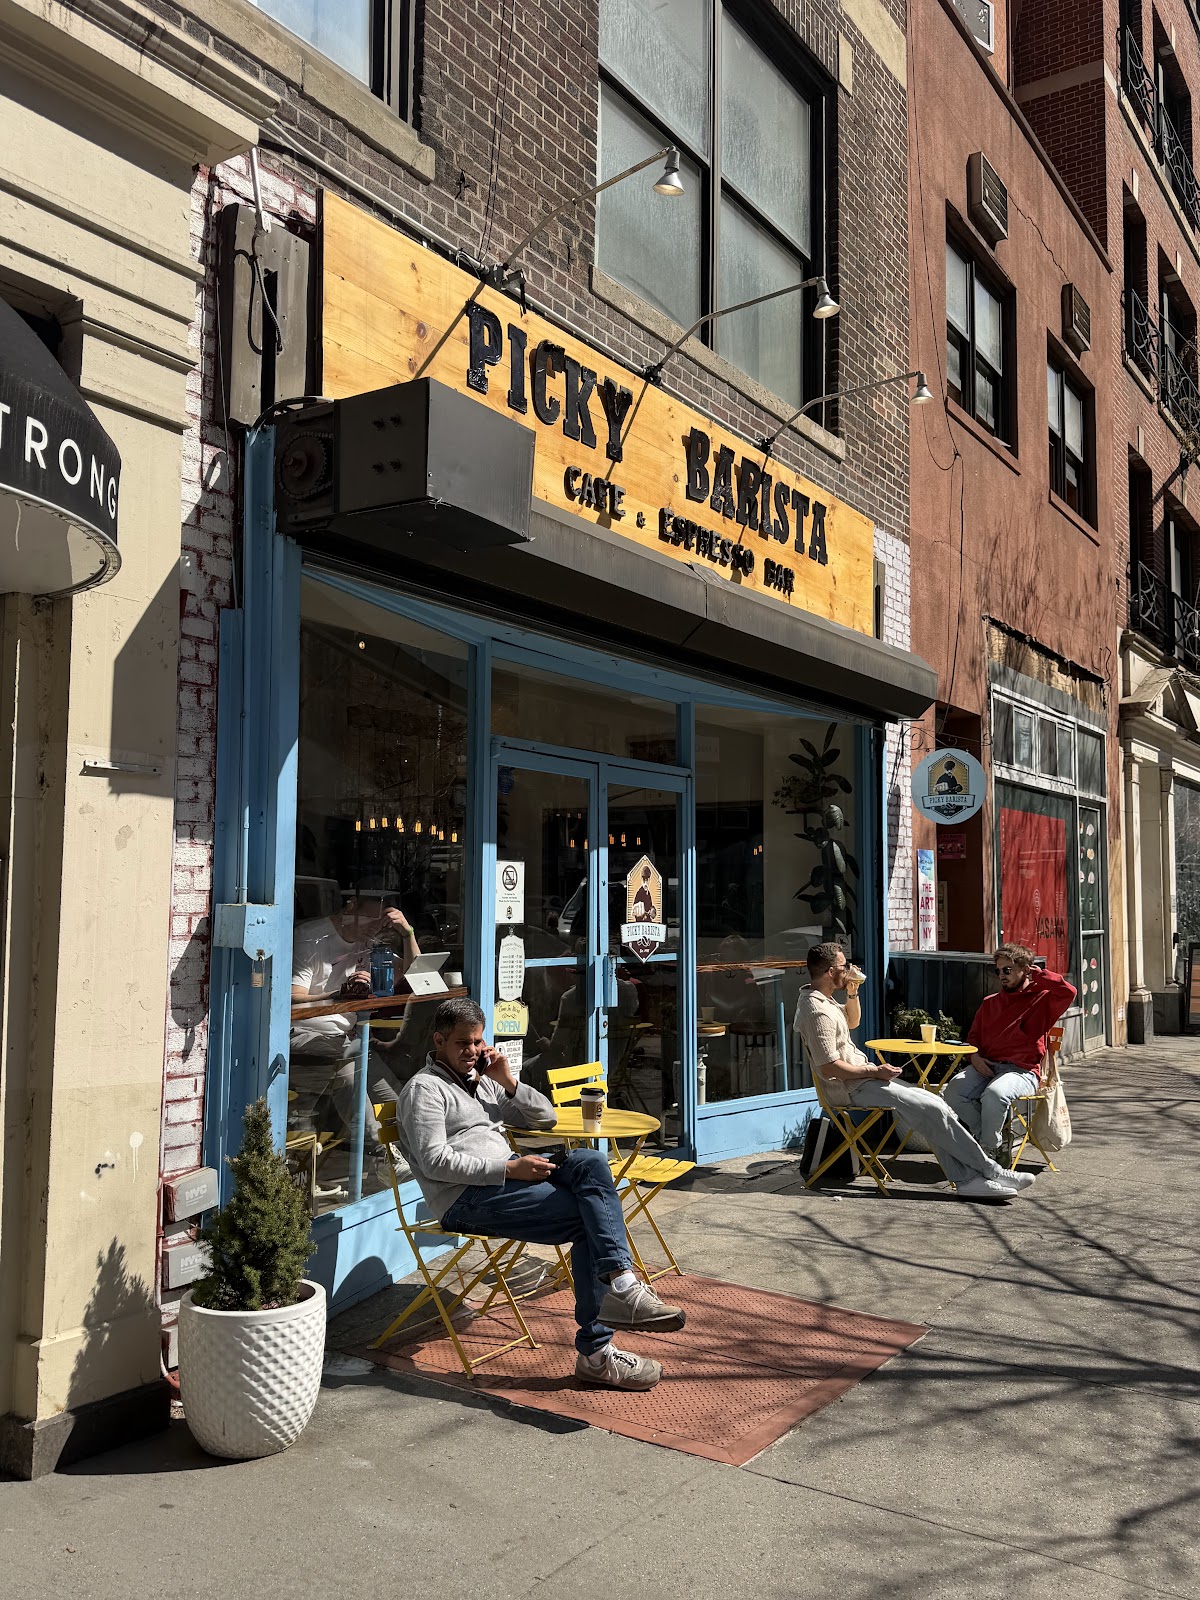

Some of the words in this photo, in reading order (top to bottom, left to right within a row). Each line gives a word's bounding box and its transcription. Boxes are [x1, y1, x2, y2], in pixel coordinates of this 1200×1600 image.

[465, 298, 633, 462] PICKY
[684, 426, 829, 566] BARISTA
[564, 466, 626, 519] CAFE
[636, 511, 646, 528] &
[659, 508, 755, 576] ESPRESSO
[764, 558, 795, 592] BAR
[922, 883, 932, 893] THE
[919, 896, 935, 910] ART
[922, 927, 932, 939] NY
[496, 1020, 521, 1033] OPEN
[185, 1184, 208, 1201] NYC
[180, 1253, 203, 1268] NYC
